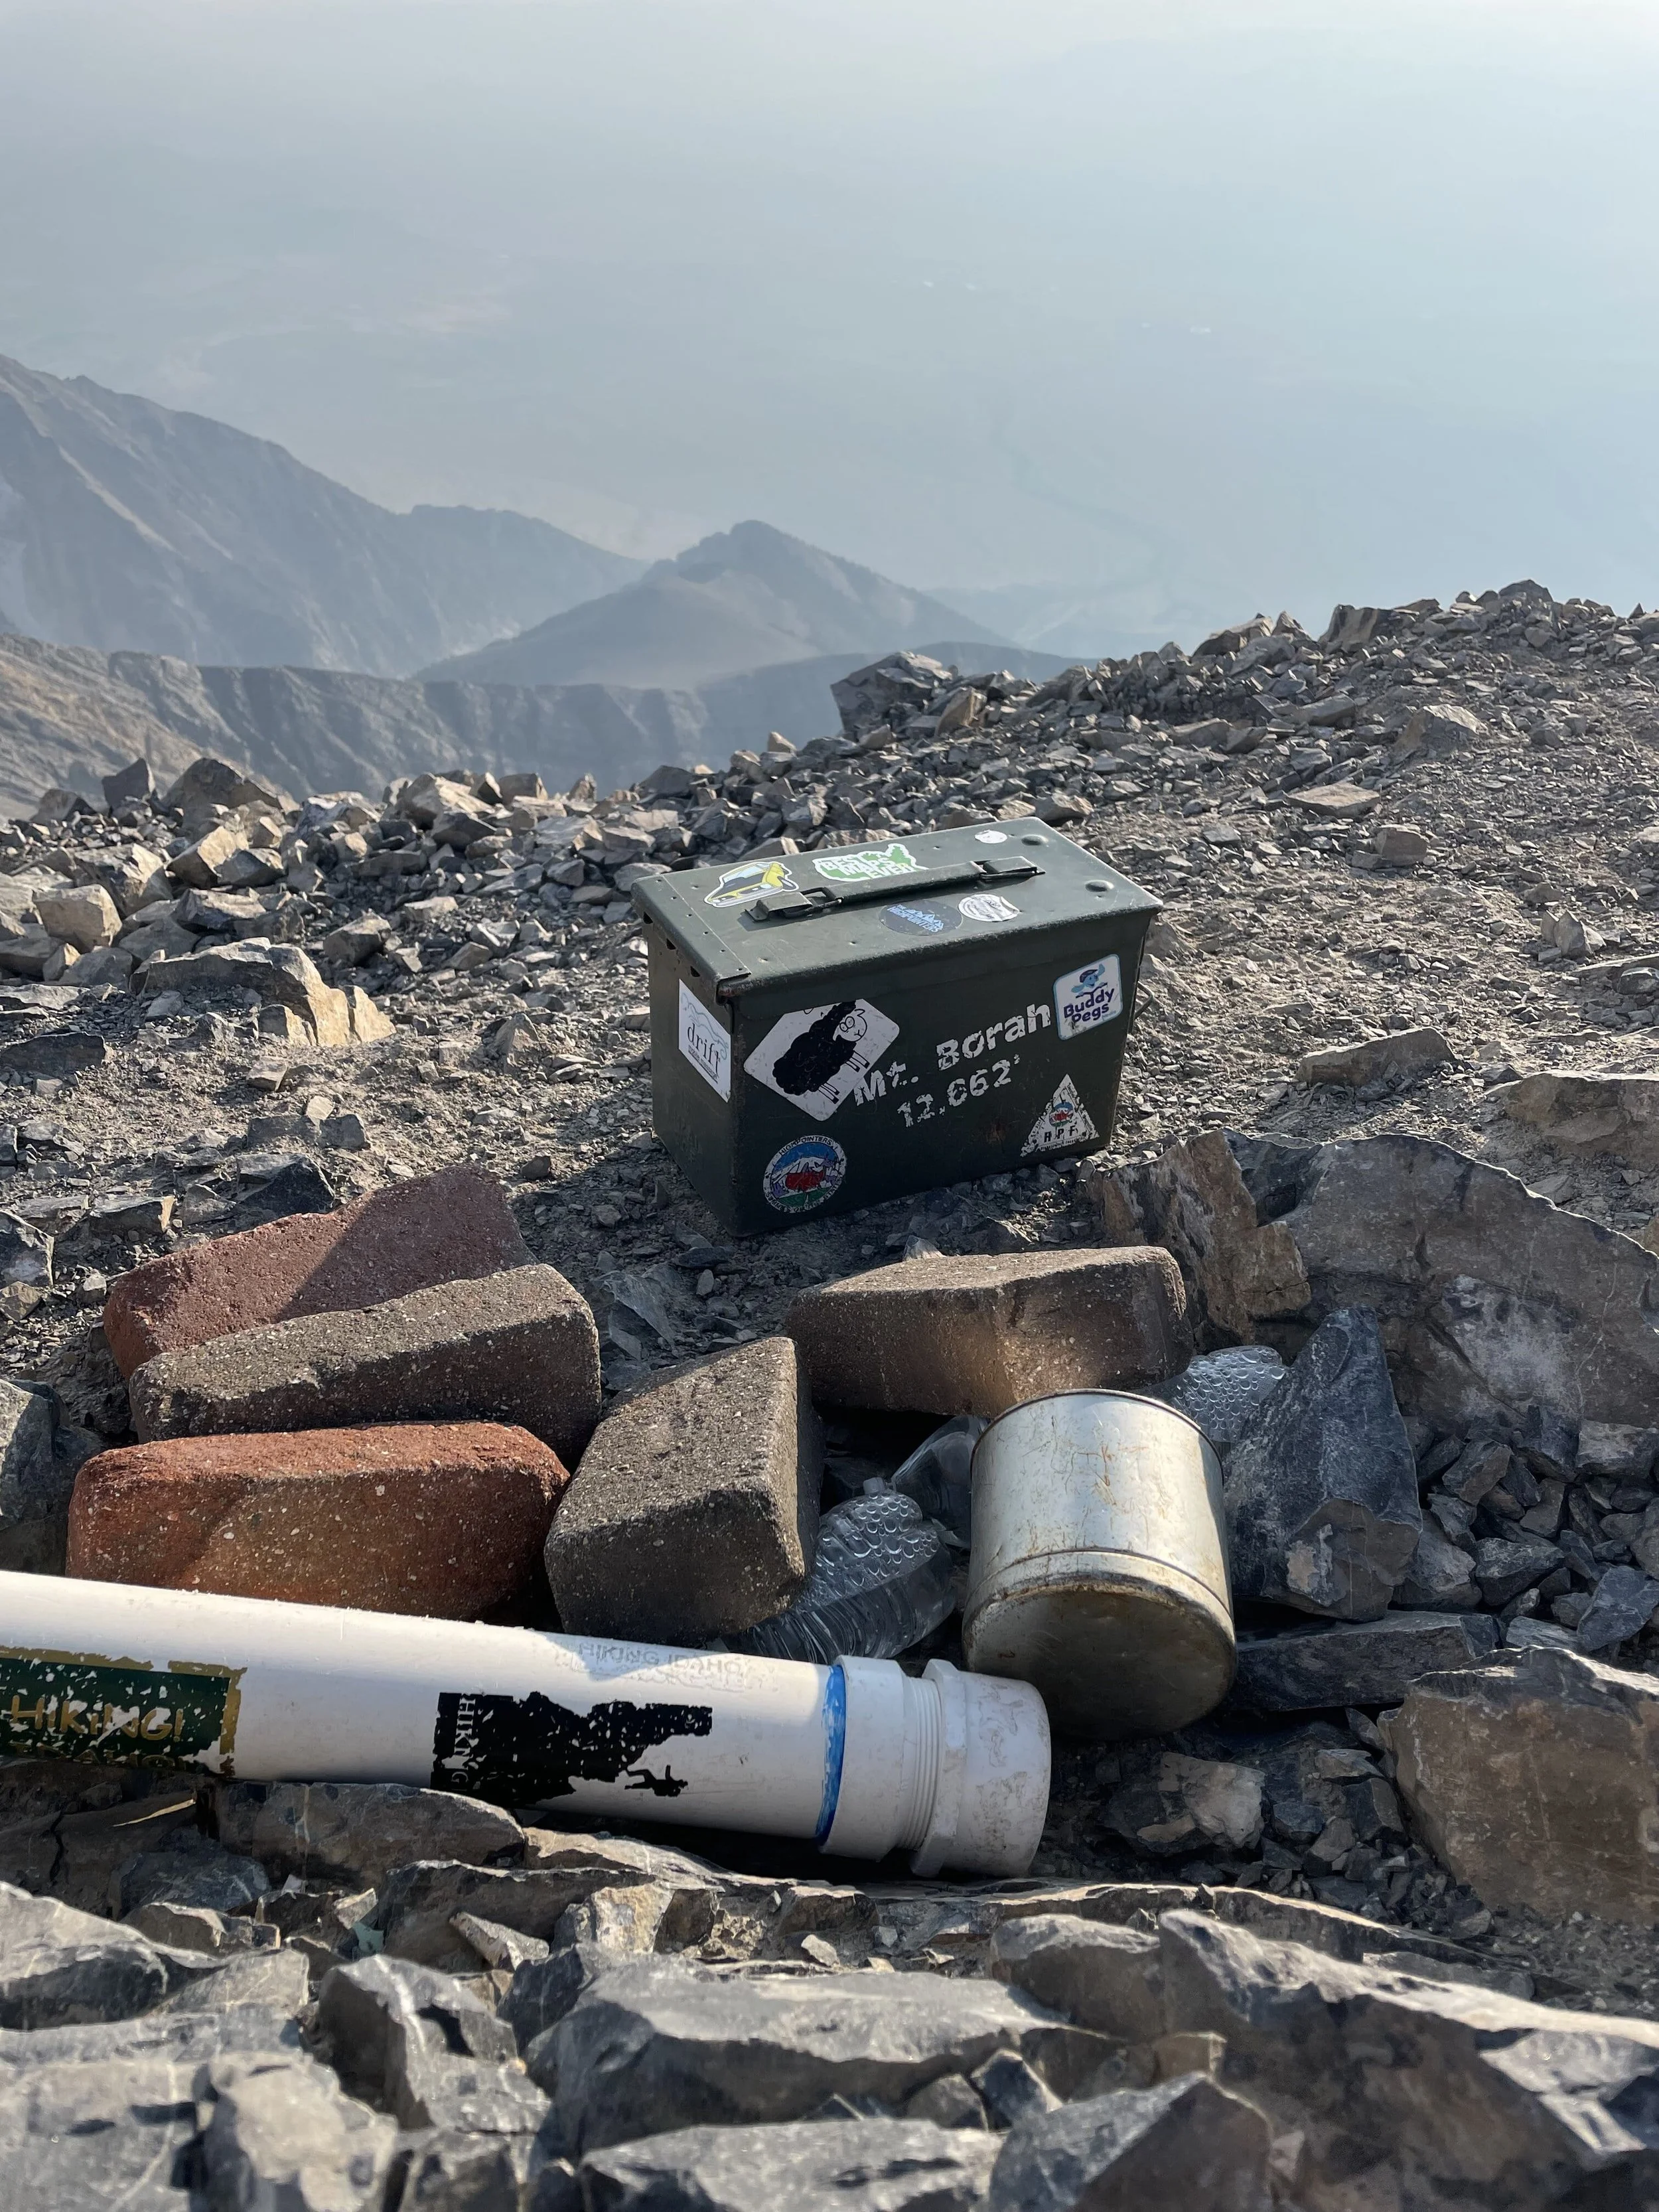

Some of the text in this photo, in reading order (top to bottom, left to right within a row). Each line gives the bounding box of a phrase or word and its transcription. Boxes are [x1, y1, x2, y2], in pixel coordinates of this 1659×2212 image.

[822, 854, 865, 871] BEST
[839, 857, 896, 876] MAPS
[865, 862, 917, 880] EVER
[1064, 988, 1115, 1019] Buddy
[687, 1023, 721, 1076] drift
[853, 1003, 1052, 1106] Mt. Borah
[778, 1136, 833, 1156] HIGHPOINTERS
[579, 1642, 660, 1666] HIKING
